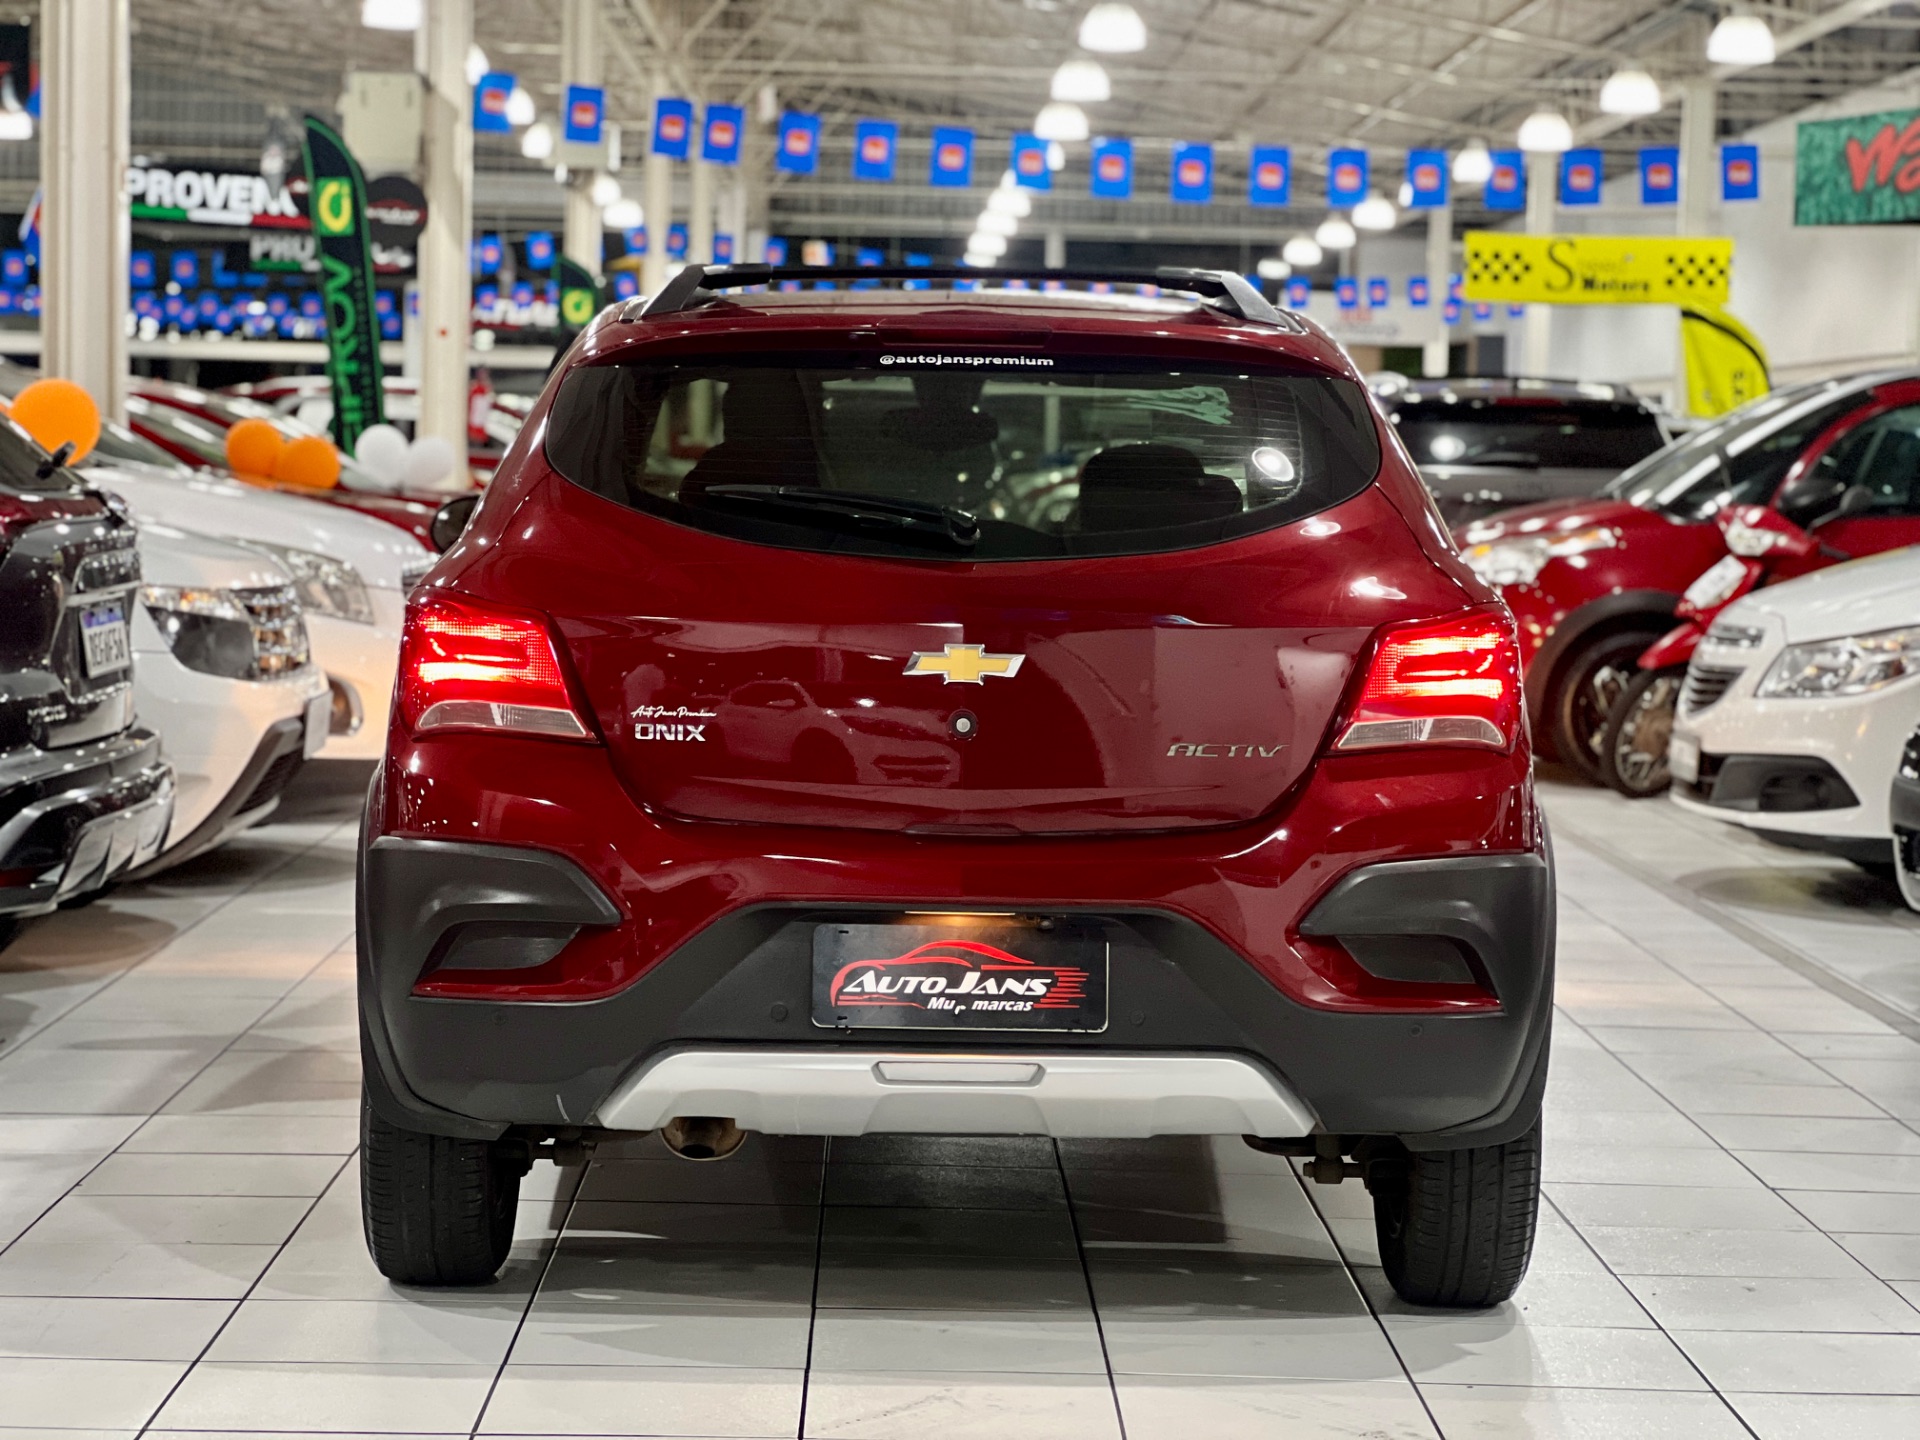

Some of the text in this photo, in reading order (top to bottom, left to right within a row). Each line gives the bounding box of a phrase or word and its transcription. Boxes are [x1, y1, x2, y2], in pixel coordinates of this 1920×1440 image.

[879, 354, 1055, 367] @autojanspremium
[634, 723, 706, 741] ONIX
[1166, 743, 1290, 757] ACTIV
[971, 999, 1034, 1012] marcas
